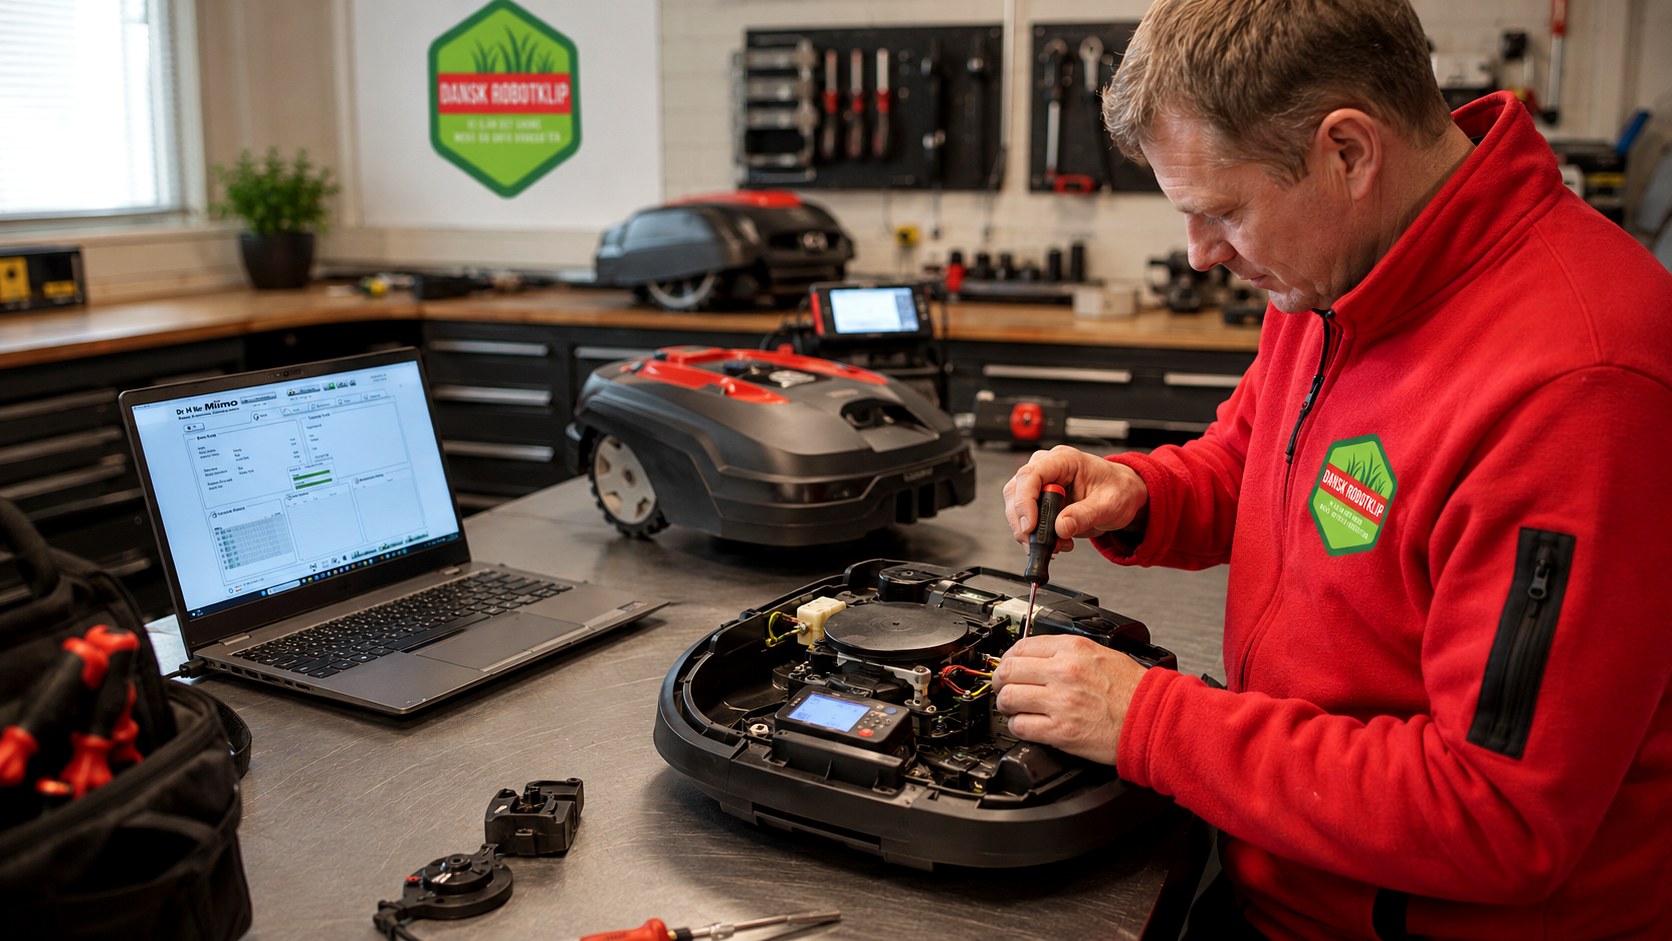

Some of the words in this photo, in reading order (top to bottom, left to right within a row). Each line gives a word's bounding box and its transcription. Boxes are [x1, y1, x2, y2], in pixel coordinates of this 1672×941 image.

[440, 82, 489, 104] DANSK
[491, 82, 569, 104] ROBOTKLIP
[1322, 469, 1349, 495] DANSK
[1345, 484, 1385, 517] ROBOTKLIP
